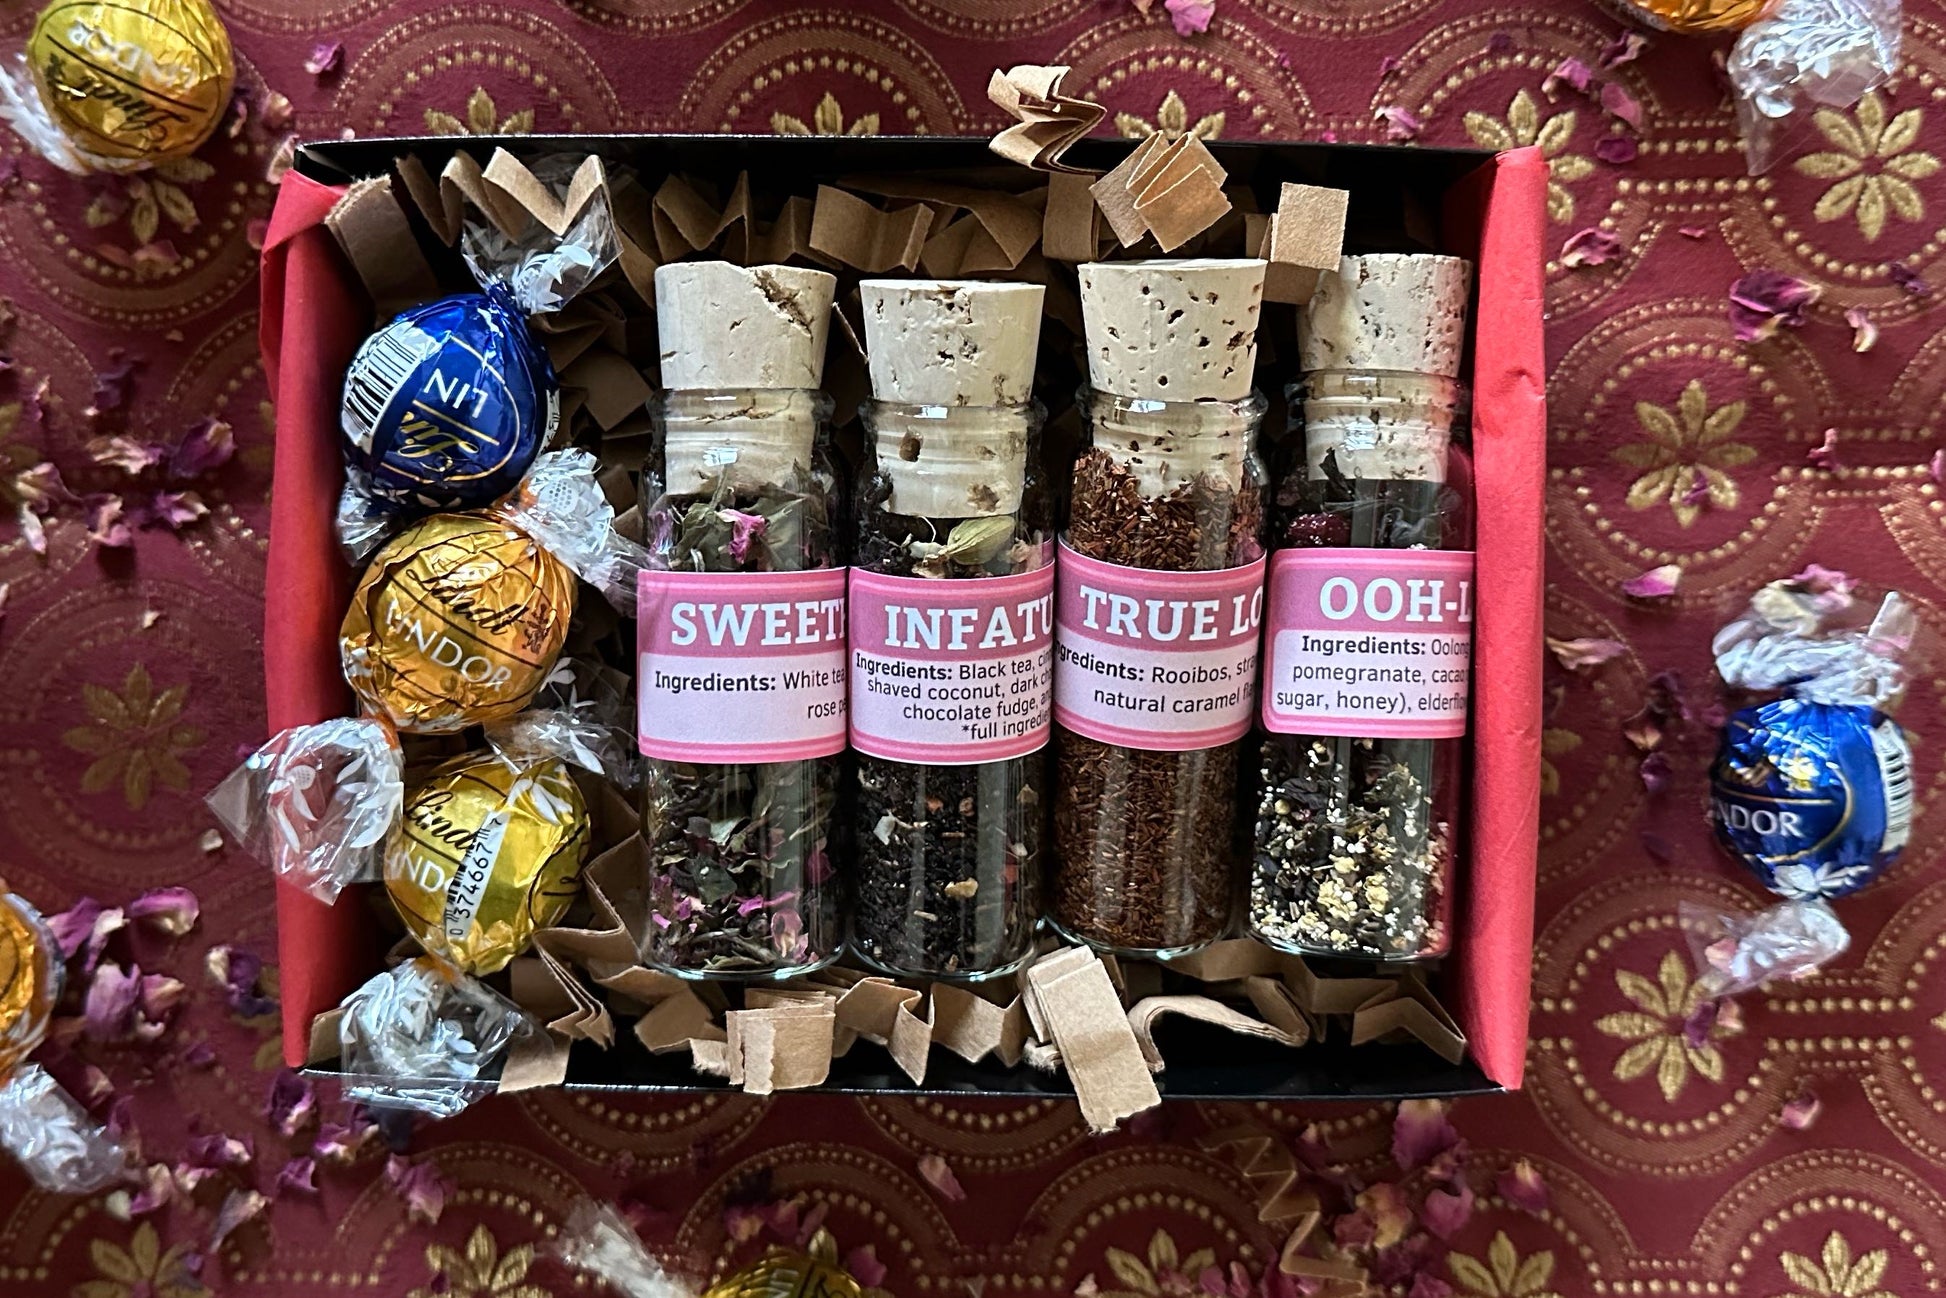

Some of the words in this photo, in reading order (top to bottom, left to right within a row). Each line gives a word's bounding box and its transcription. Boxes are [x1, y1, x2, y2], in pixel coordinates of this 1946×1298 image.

[1080, 585, 1220, 642] TRUE
[1230, 585, 1264, 637] LO
[1302, 635, 1426, 656] Ingredients:
[856, 652, 952, 680] Ingredients:
[959, 662, 1006, 680] Black
[1011, 658, 1035, 676] tea,
[1055, 641, 1144, 681] ngredients:
[1152, 665, 1232, 684] Rooibos,
[1293, 664, 1426, 685] pomegranate,
[655, 670, 776, 694] Ingredients:
[783, 669, 829, 690] White
[867, 676, 921, 699] shaved
[928, 683, 1005, 701] coconut,
[1011, 674, 1038, 695] dark
[807, 701, 837, 719] rose
[903, 703, 991, 721] chocolate
[997, 697, 1038, 717] fudge,
[1094, 688, 1165, 712] natural
[1173, 690, 1240, 713] caramel
[1277, 691, 1329, 710] sugar,
[1337, 690, 1412, 713] honey),
[453, 841, 494, 919] 374667
